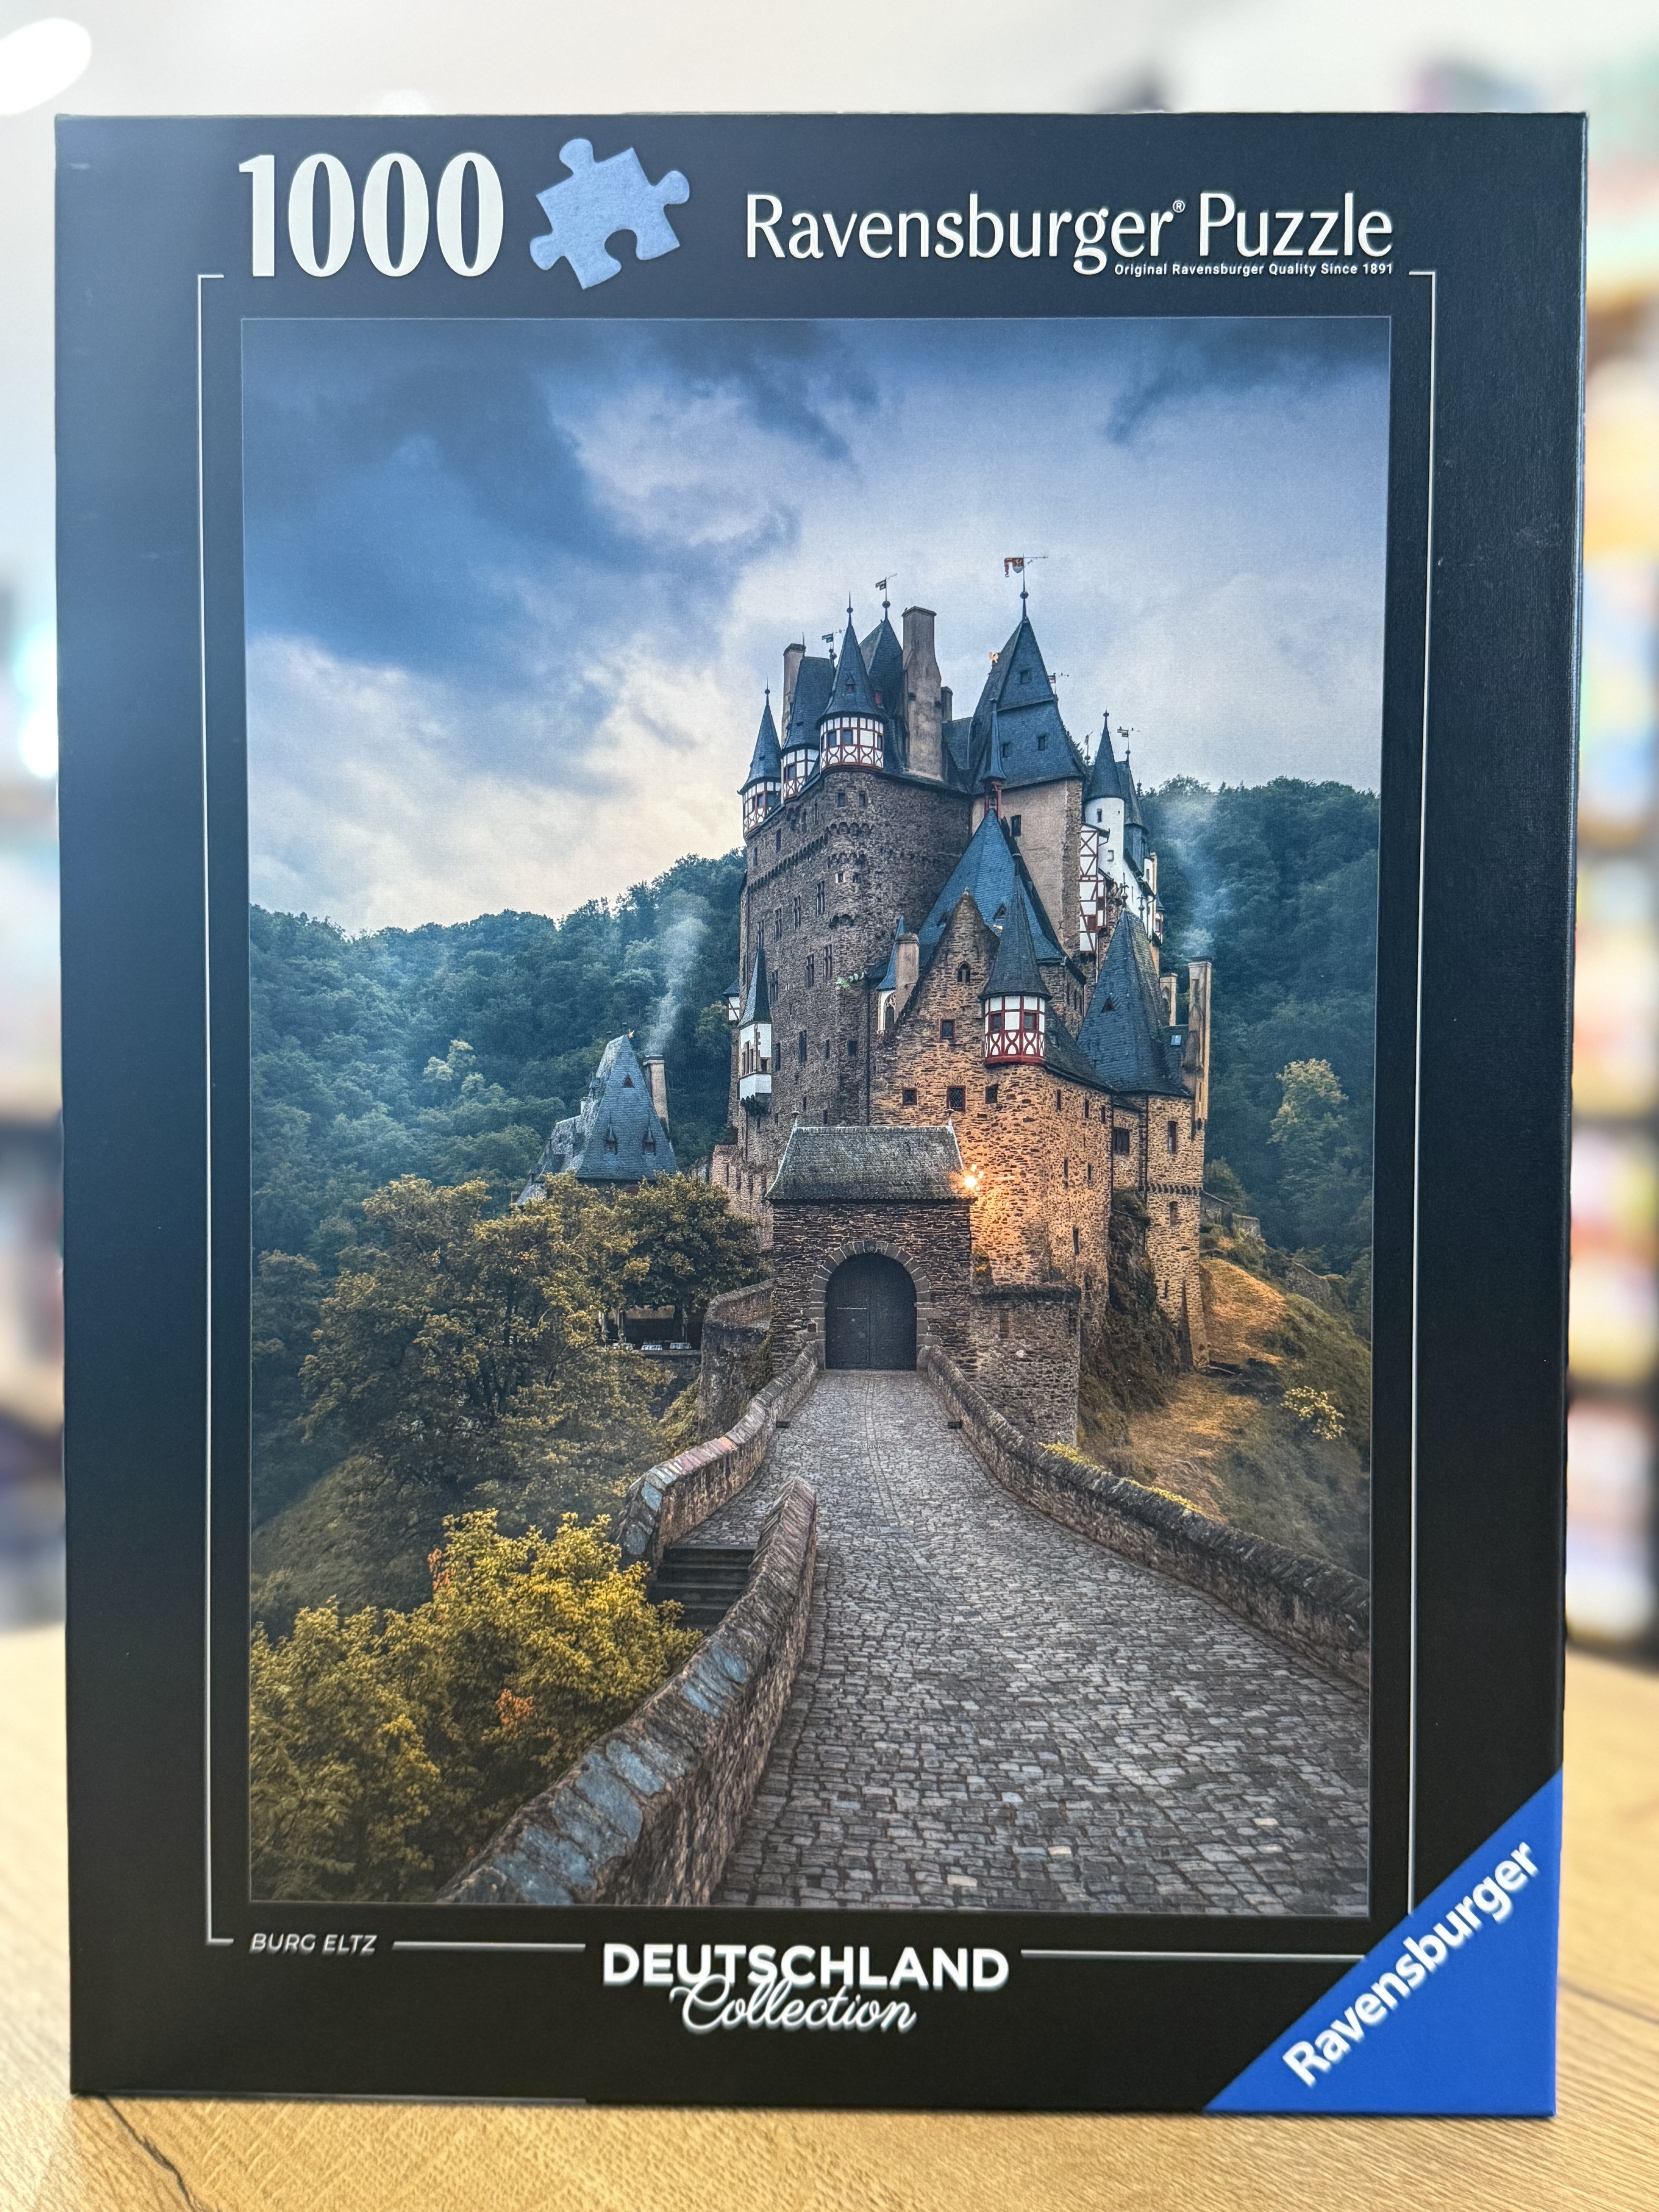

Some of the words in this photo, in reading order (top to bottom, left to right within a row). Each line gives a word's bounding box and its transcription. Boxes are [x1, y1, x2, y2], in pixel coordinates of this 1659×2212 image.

[239, 152, 503, 277] 1000
[1199, 192, 1392, 258] Puzzle
[1114, 263, 1167, 278] Original
[1172, 262, 1264, 277] Ravensburger
[1269, 262, 1316, 277] Quality
[1321, 263, 1358, 275] Since
[1362, 263, 1392, 275] 1891
[249, 1932, 317, 1953] BURG
[322, 1933, 378, 1954] ELTZ
[602, 1942, 1010, 1991] DEUTSCHLAND
[1282, 1841, 1539, 2088] Ravensburger
[671, 1973, 918, 2033] Collection
